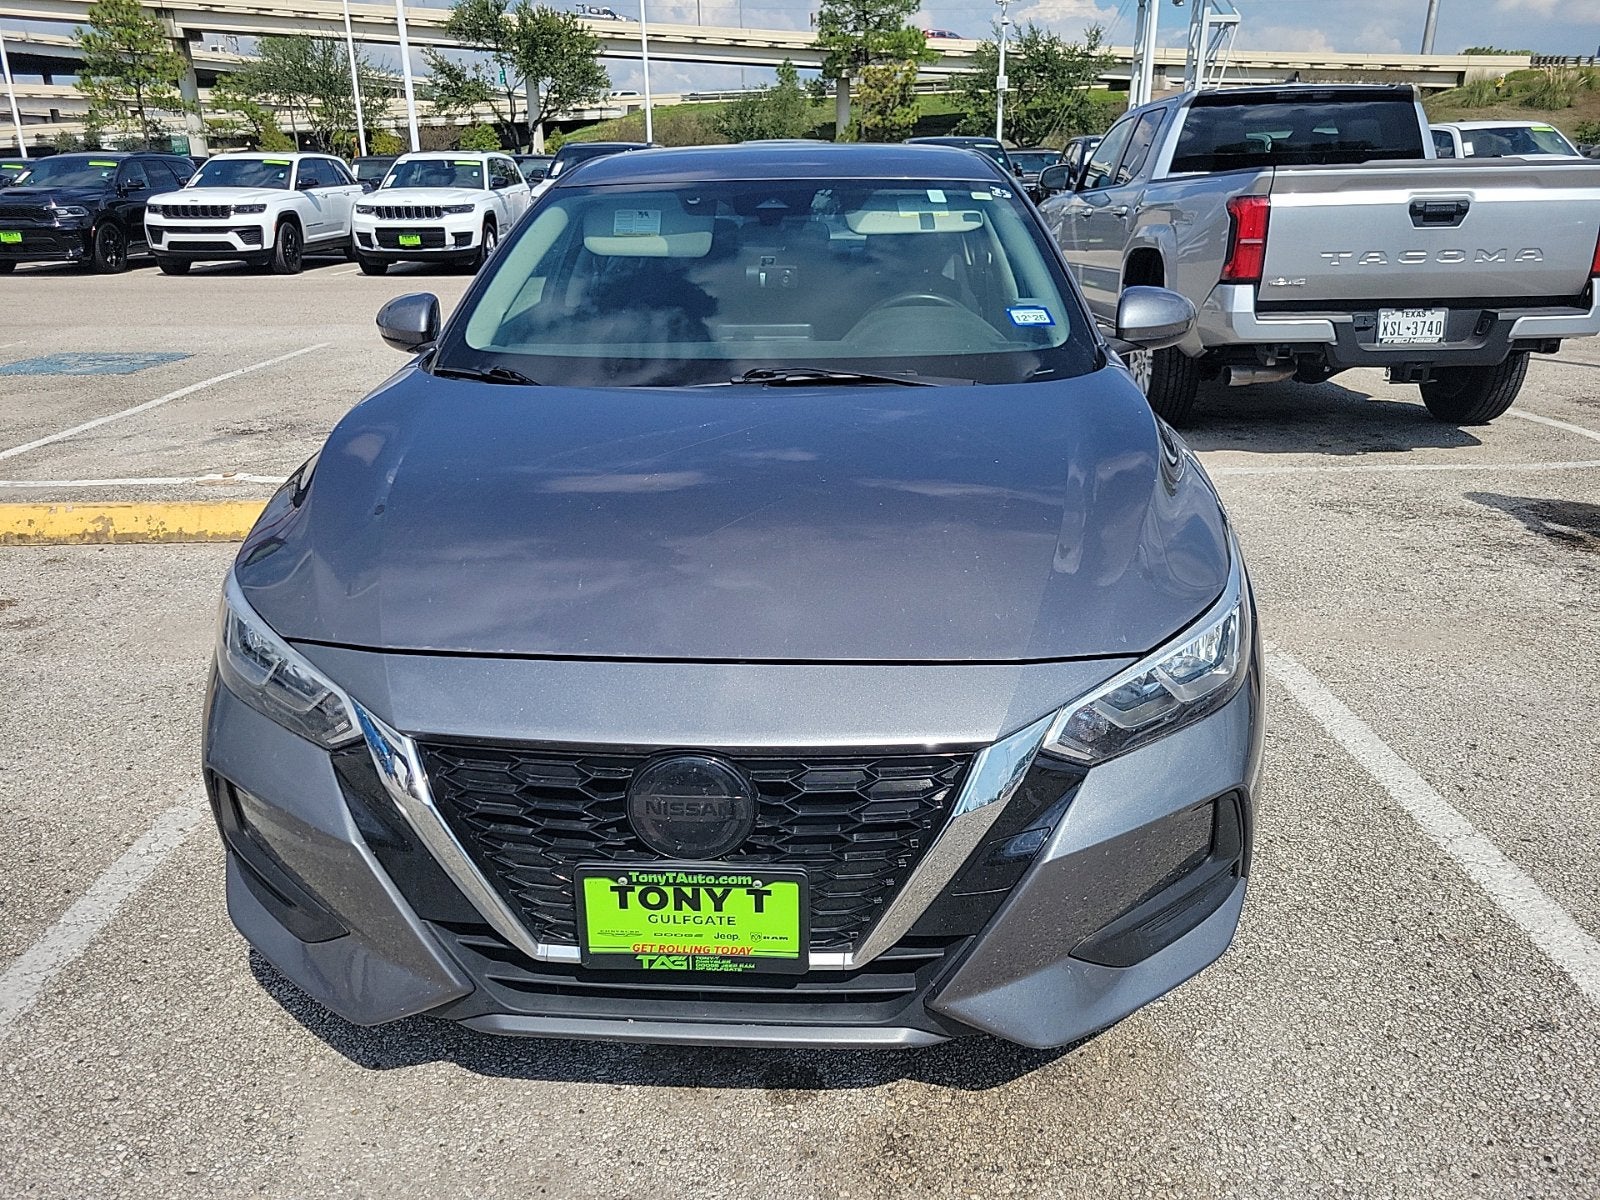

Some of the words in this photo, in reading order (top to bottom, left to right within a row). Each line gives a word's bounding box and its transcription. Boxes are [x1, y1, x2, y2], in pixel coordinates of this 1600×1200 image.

[1320, 247, 1544, 266] TACOMA
[645, 800, 735, 817] NISSAN
[629, 871, 753, 886] TonyTAuto.com
[610, 885, 732, 912] TONY
[746, 889, 772, 913] T
[647, 914, 737, 926] GULFGATE
[714, 932, 739, 941] Jeep
[632, 943, 656, 953] GET
[658, 944, 711, 954] ROLLING
[713, 946, 754, 955] TODAY
[635, 954, 688, 970] TAG
